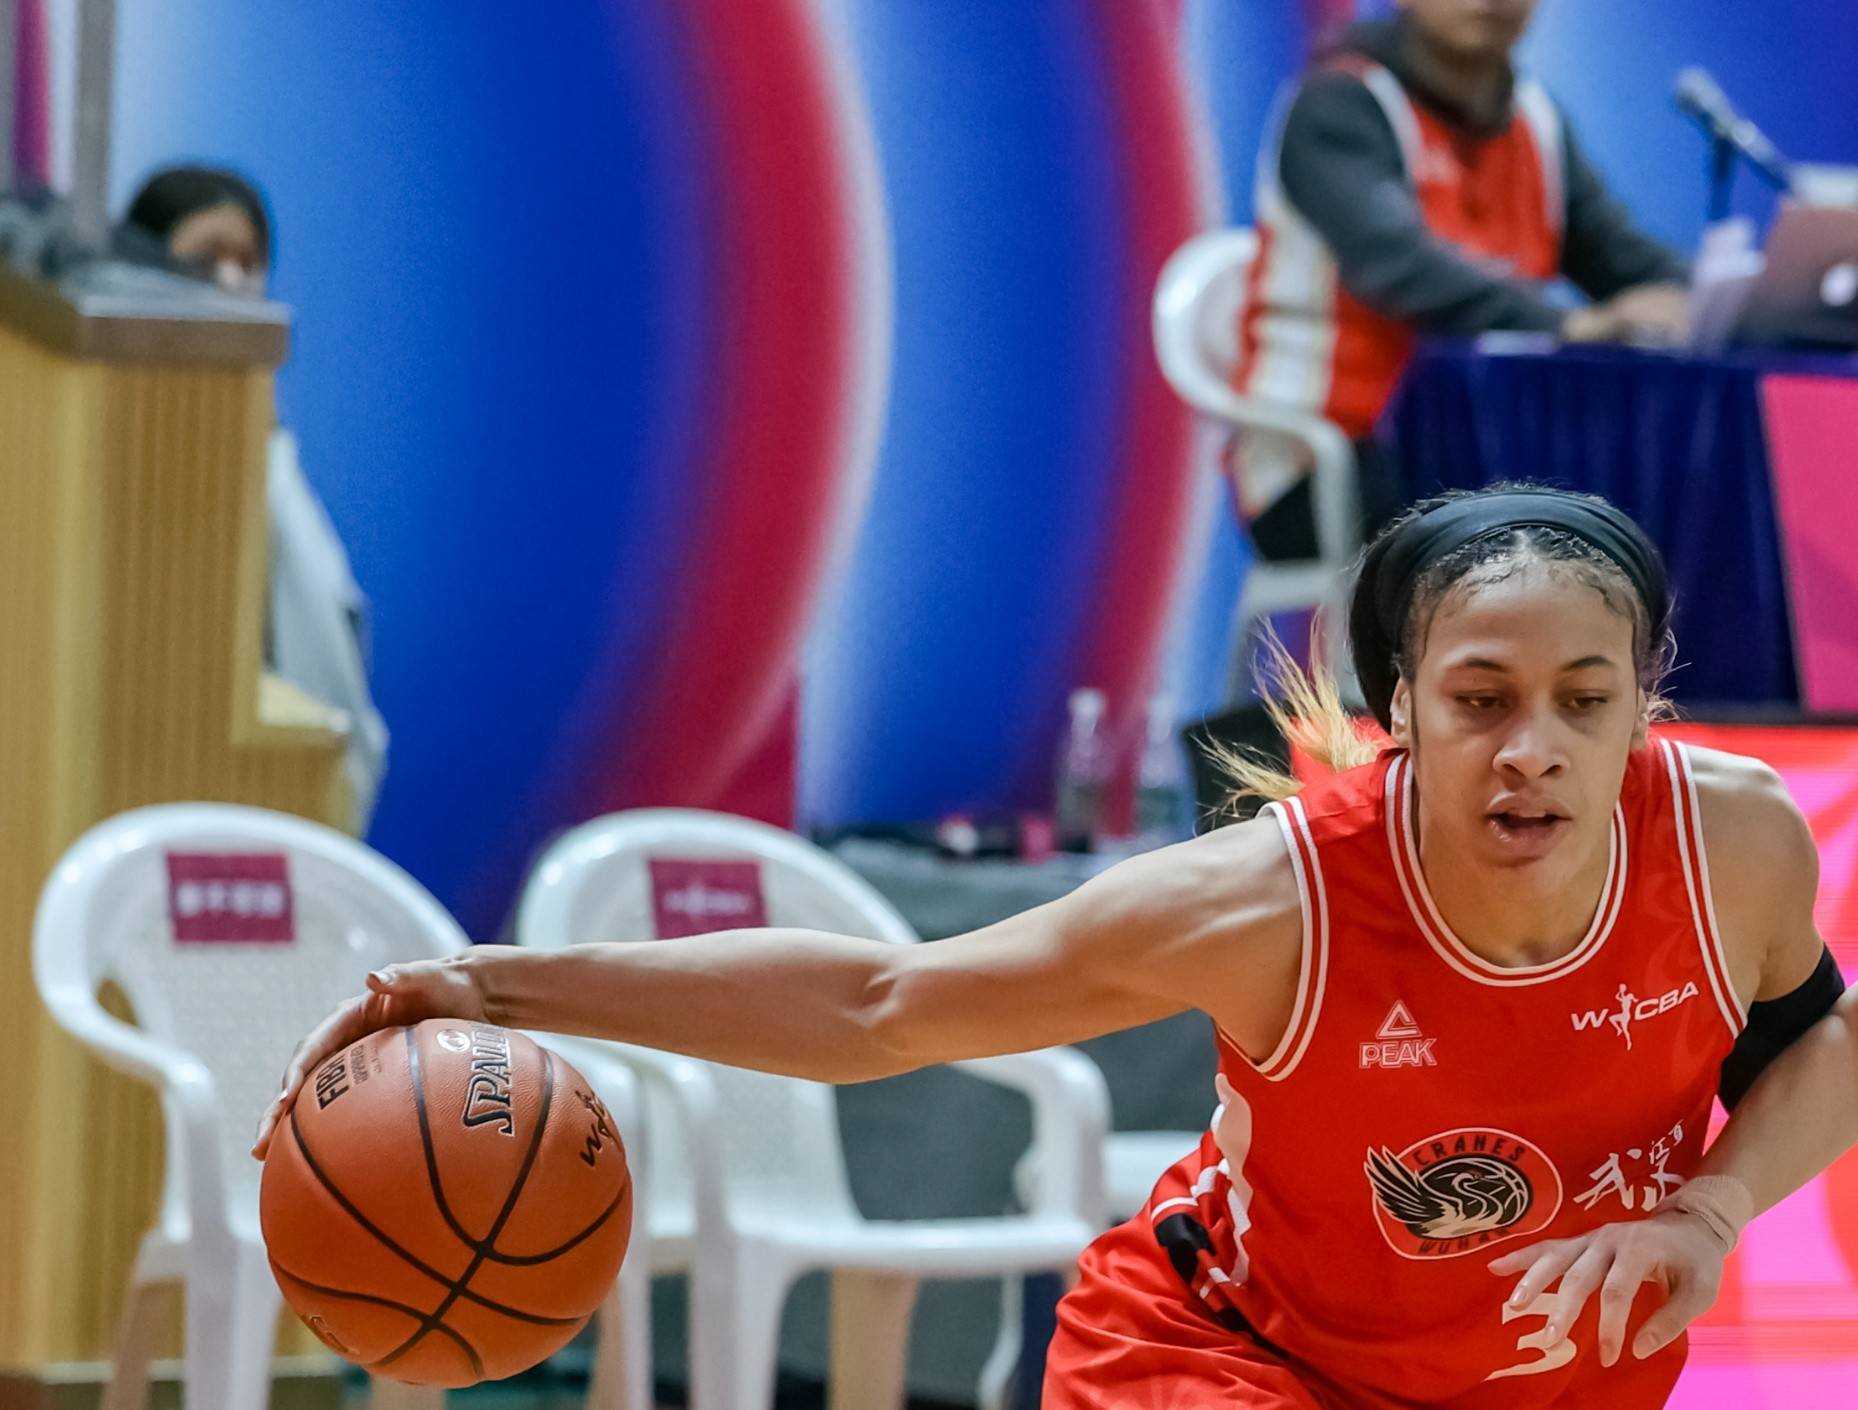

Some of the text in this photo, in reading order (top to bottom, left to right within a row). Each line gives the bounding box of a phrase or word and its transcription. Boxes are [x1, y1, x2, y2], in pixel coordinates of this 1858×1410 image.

[1570, 980, 1700, 1033] WCBA
[1358, 1037, 1438, 1069] PEAK
[1412, 1134, 1526, 1167] CRANES
[1482, 1291, 1578, 1381] 3
